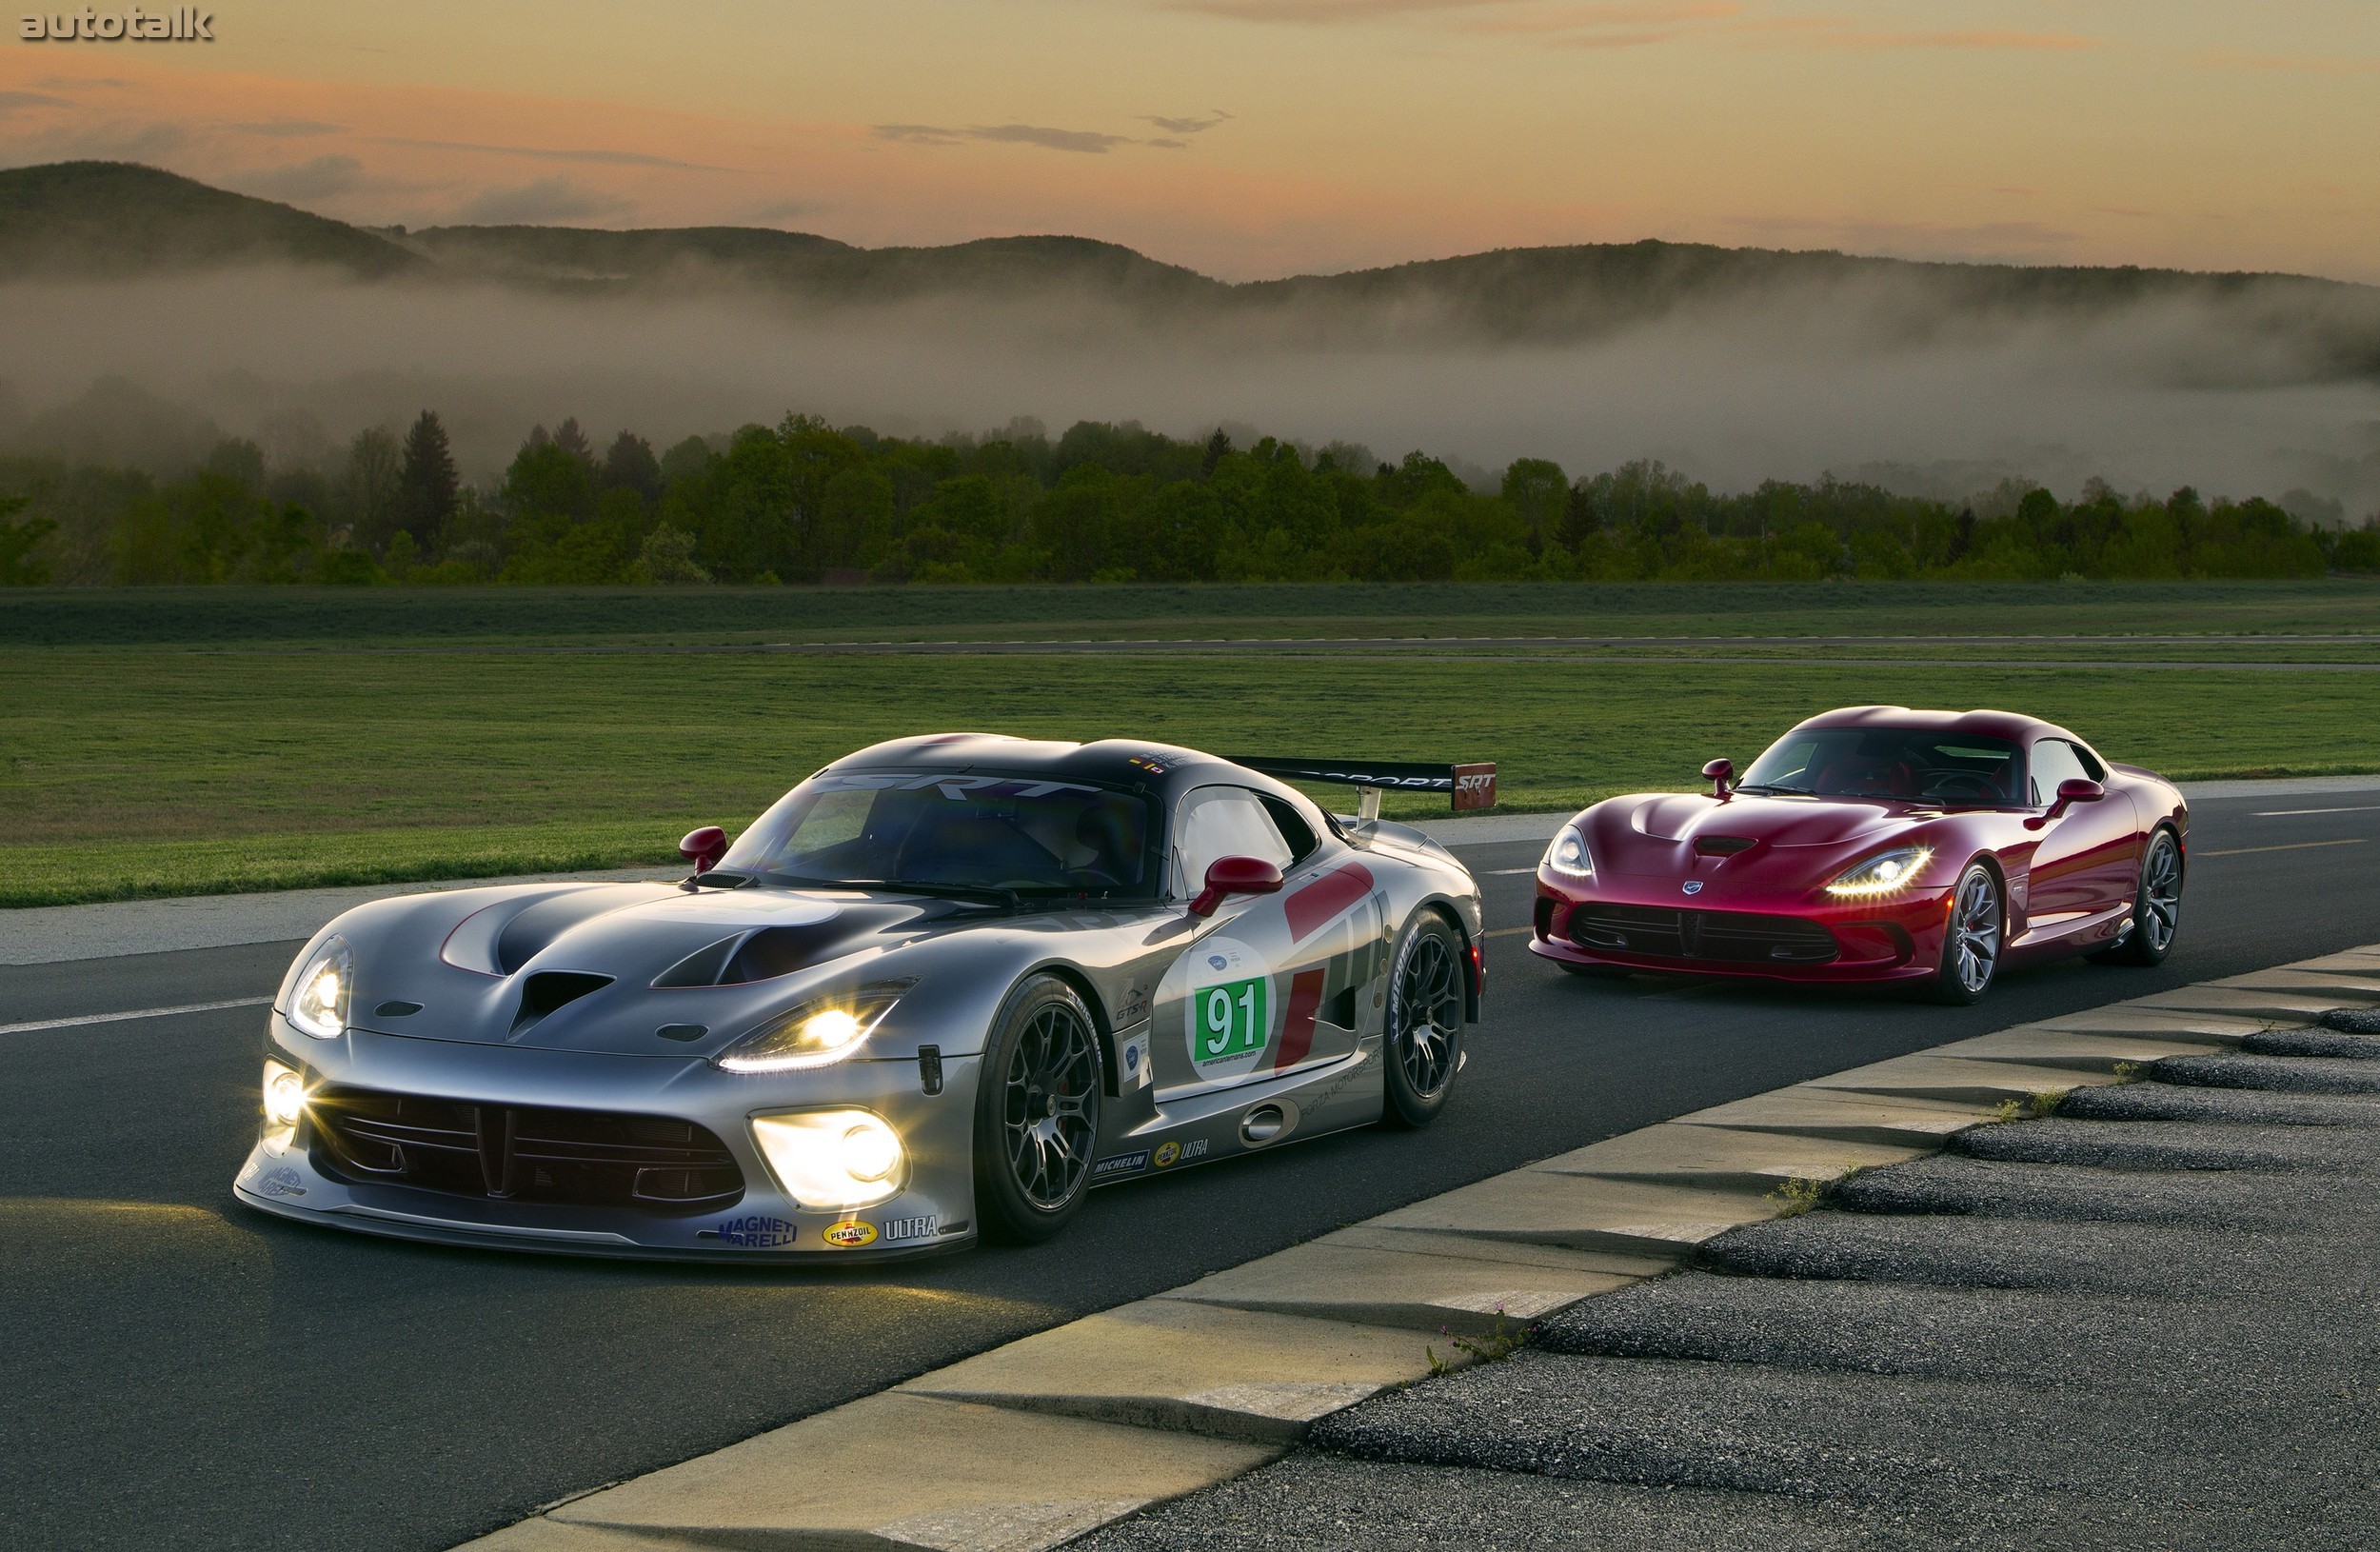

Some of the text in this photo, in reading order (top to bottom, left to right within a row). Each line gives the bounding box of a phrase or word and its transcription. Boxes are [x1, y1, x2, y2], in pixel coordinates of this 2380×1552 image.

[810, 773, 1104, 801] SRT
[1456, 774, 1496, 790] SRT
[1117, 1001, 1147, 1021] GTS-R
[1206, 984, 1256, 1055] 91
[1300, 1091, 1330, 1121] FORZA
[1180, 1139, 1208, 1159] ULTRA
[1095, 1155, 1145, 1173] MICHELIN
[718, 1216, 798, 1236] MAGNETI
[830, 1226, 871, 1241] PENNZOIL
[883, 1215, 938, 1241] ULTRA
